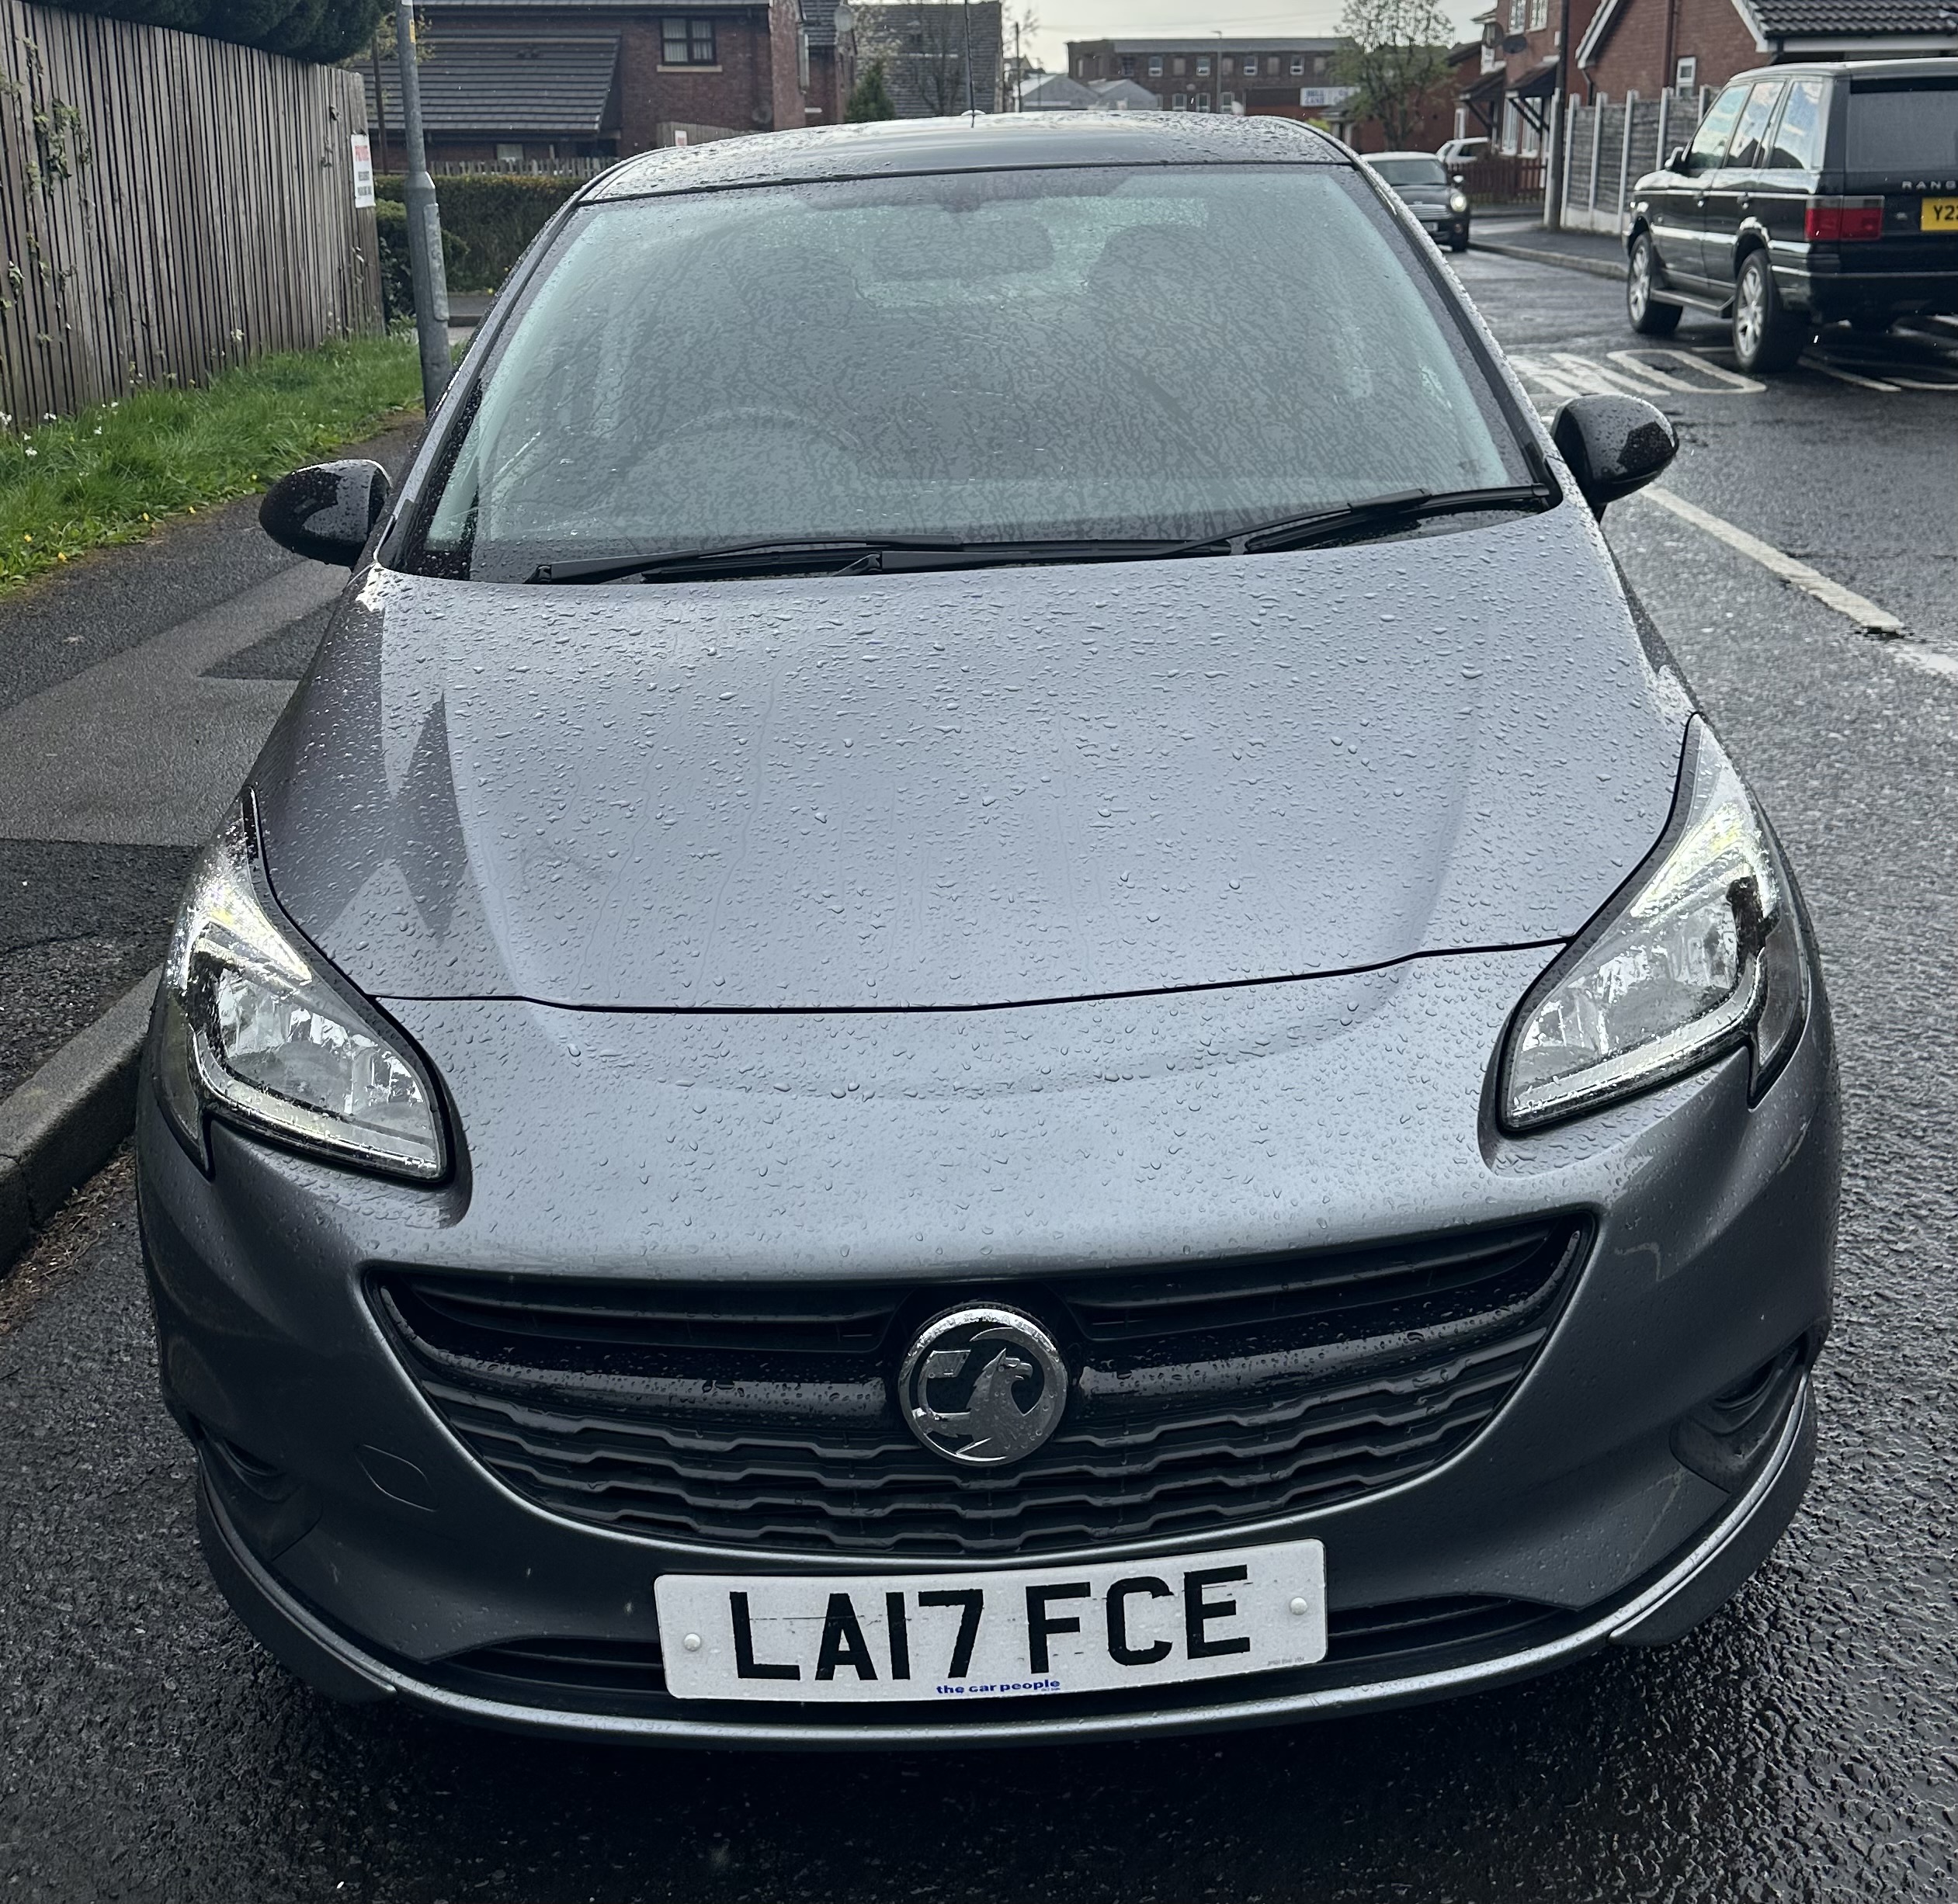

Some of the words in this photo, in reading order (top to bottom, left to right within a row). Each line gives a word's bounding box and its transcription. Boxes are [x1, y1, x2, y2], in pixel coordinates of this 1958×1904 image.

[1933, 204, 1958, 221] Y2
[729, 1589, 984, 1680] LA17
[1026, 1564, 1251, 1673] FCE
[936, 1684, 965, 1694] the
[968, 1684, 997, 1693] car
[1000, 1679, 1061, 1692] people
